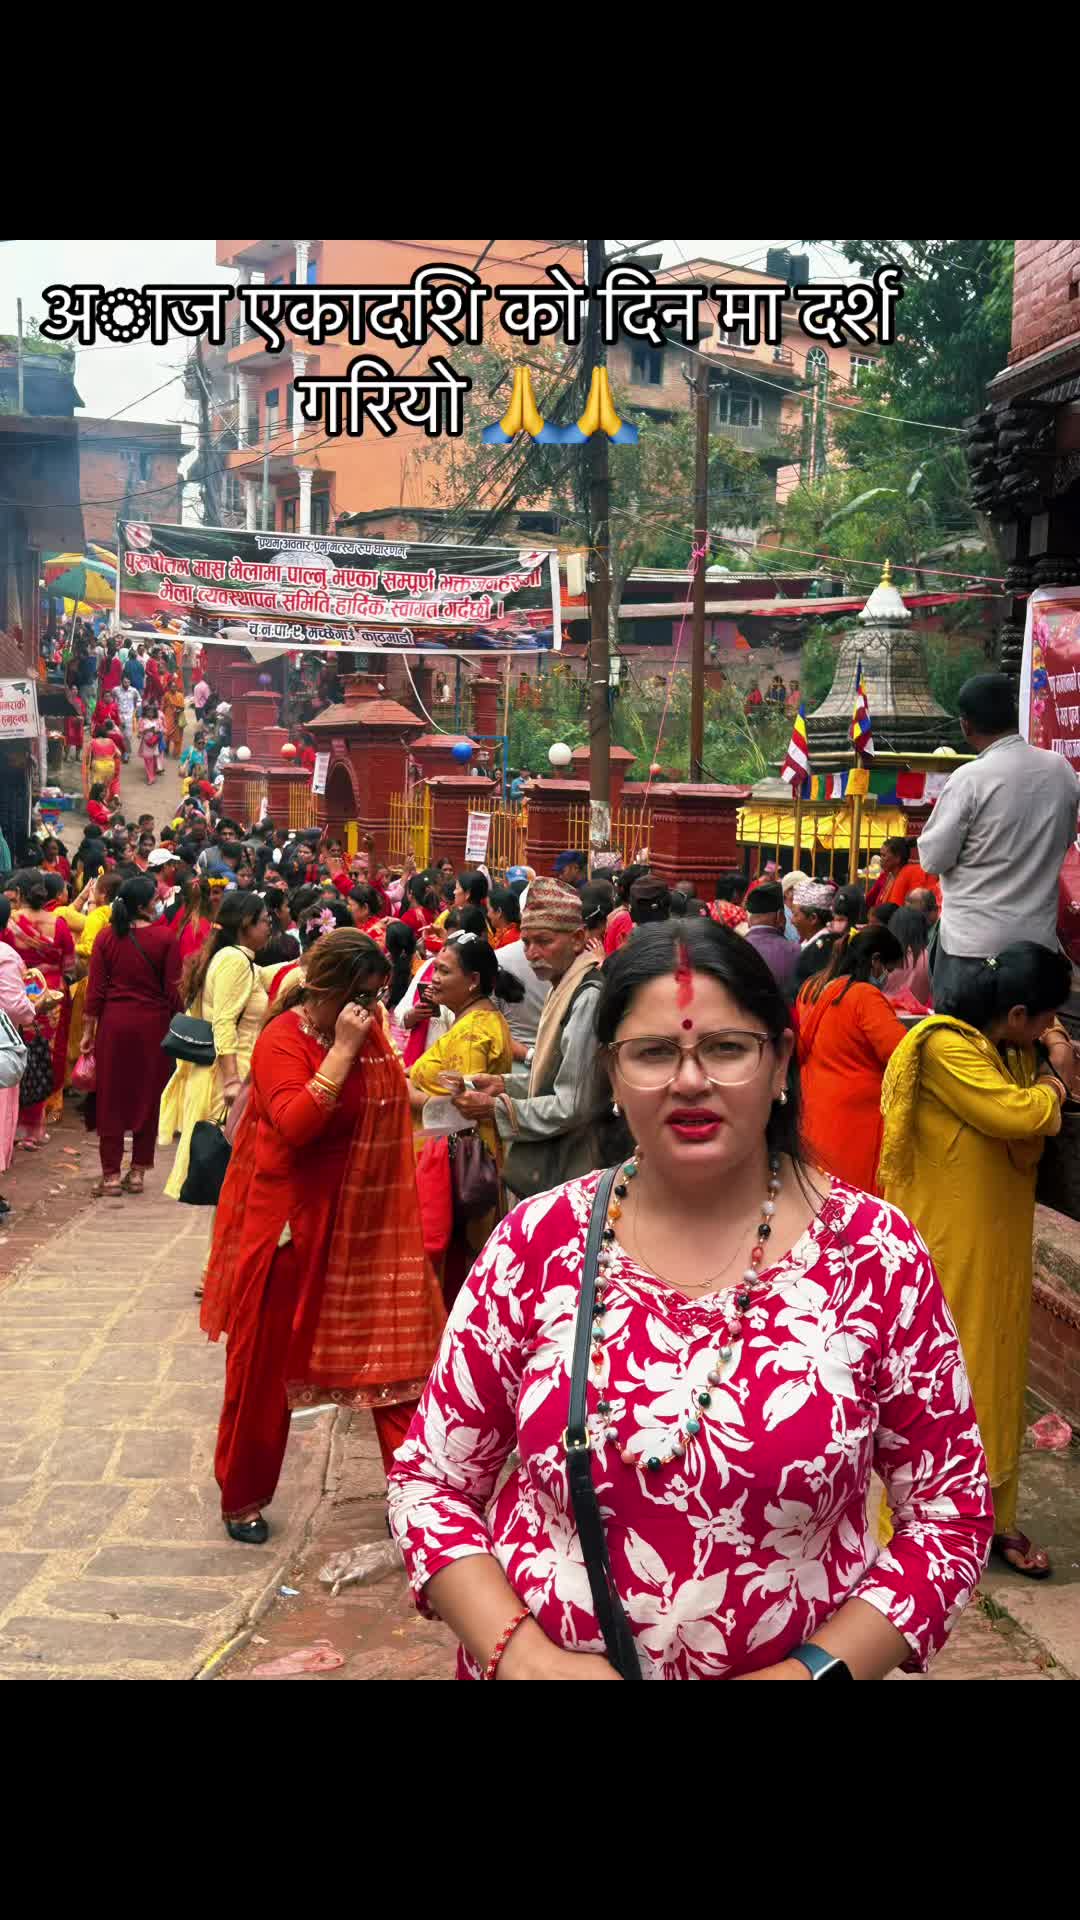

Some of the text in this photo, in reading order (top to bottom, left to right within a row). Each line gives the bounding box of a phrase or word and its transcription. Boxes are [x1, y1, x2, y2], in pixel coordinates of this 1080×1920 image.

[192, 560, 226, 580] मास
[229, 556, 282, 583] मेलामा
[286, 565, 330, 590] पाल्नु
[331, 568, 379, 589] भएका
[382, 568, 436, 597] सम्पूर्ण
[159, 578, 194, 603] मेला
[197, 585, 279, 610] व्यवस्थापन
[281, 589, 332, 614] समिति
[334, 592, 387, 617] हार्दिक
[391, 600, 440, 619] स्वागत
